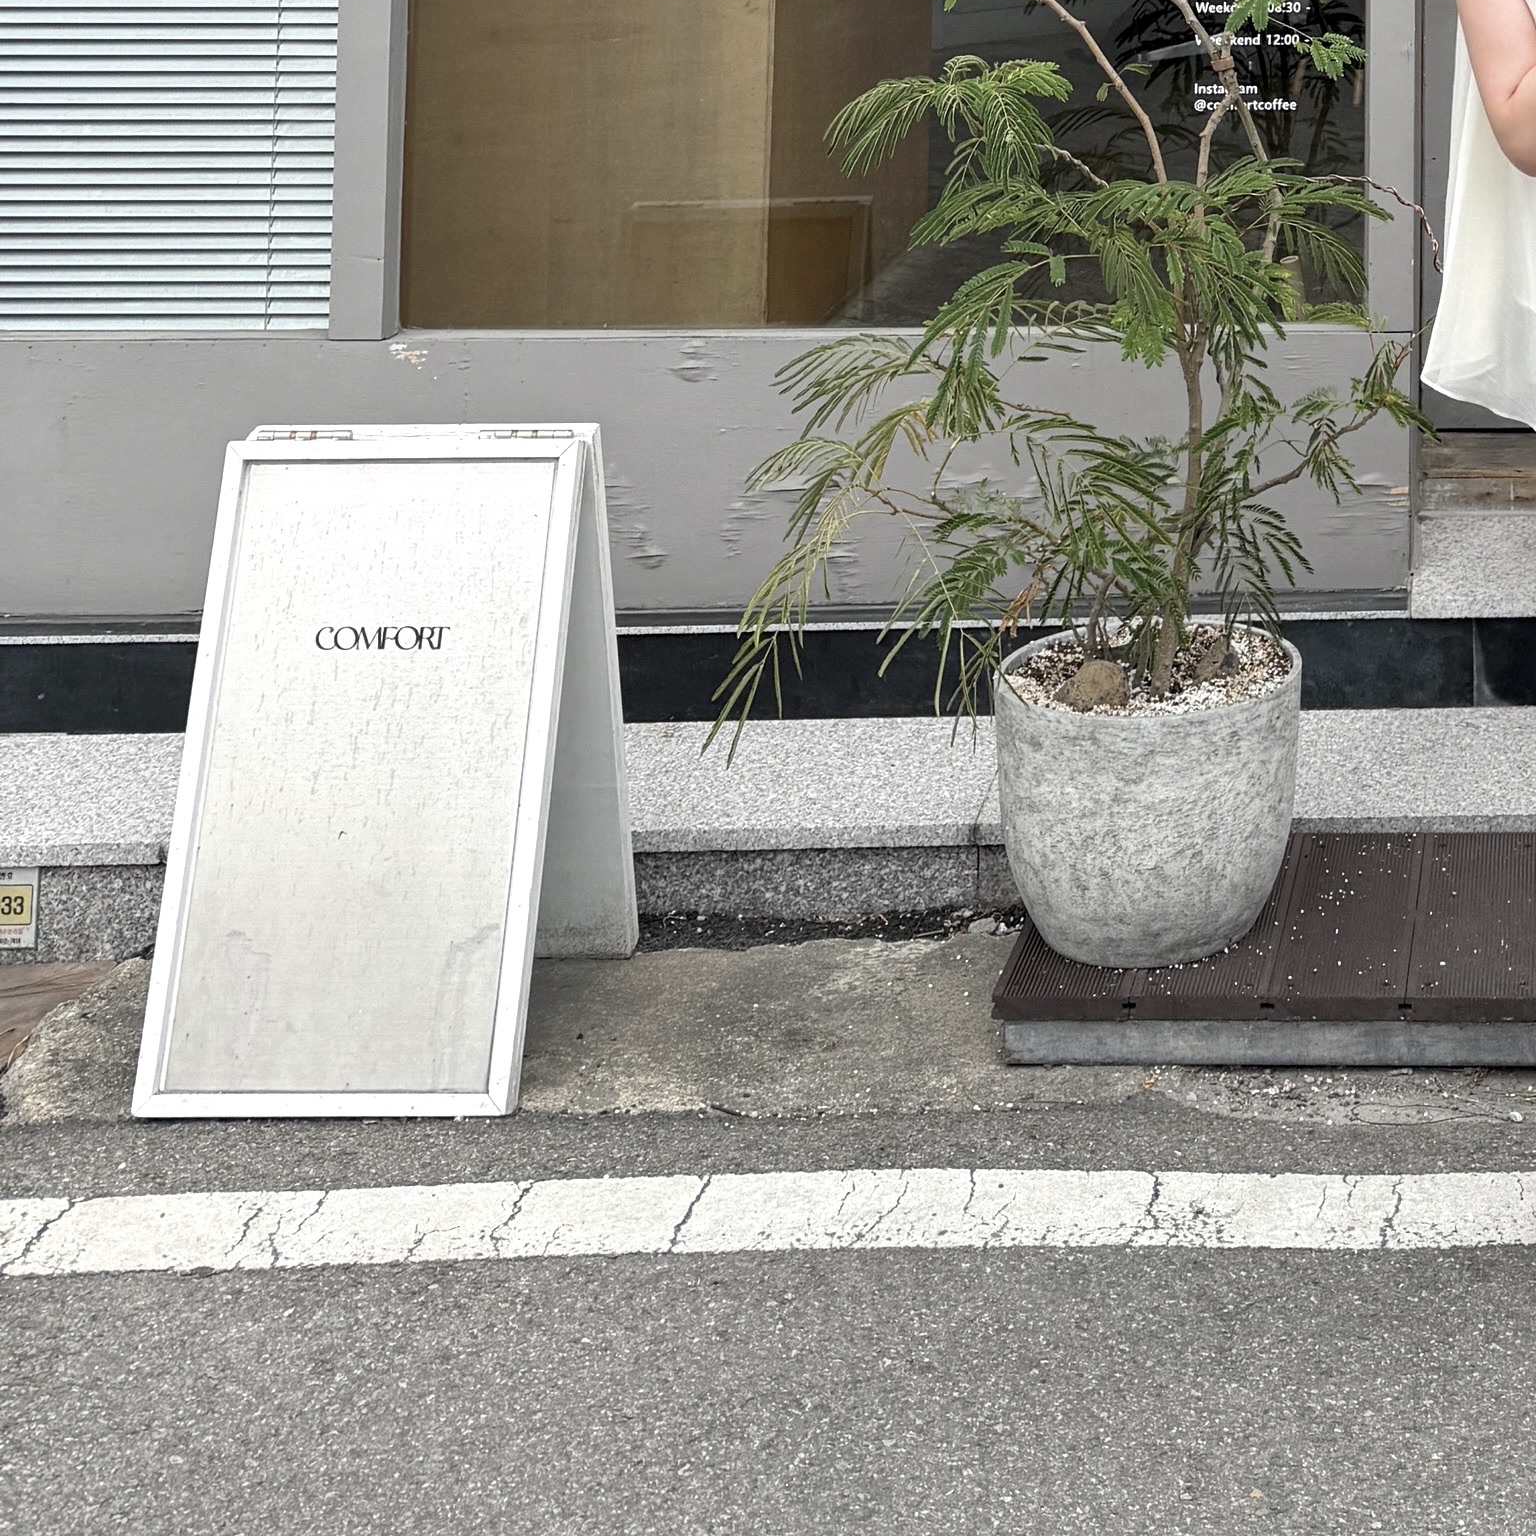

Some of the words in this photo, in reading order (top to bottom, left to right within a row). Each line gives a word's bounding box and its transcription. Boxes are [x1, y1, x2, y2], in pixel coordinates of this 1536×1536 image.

[1267, 1, 1301, 14] 08:30
[1266, 34, 1300, 46] 12:00
[1194, 83, 1258, 96] Instaam
[1194, 98, 1297, 112] @cortcoffee
[315, 625, 451, 651] COMFORT
